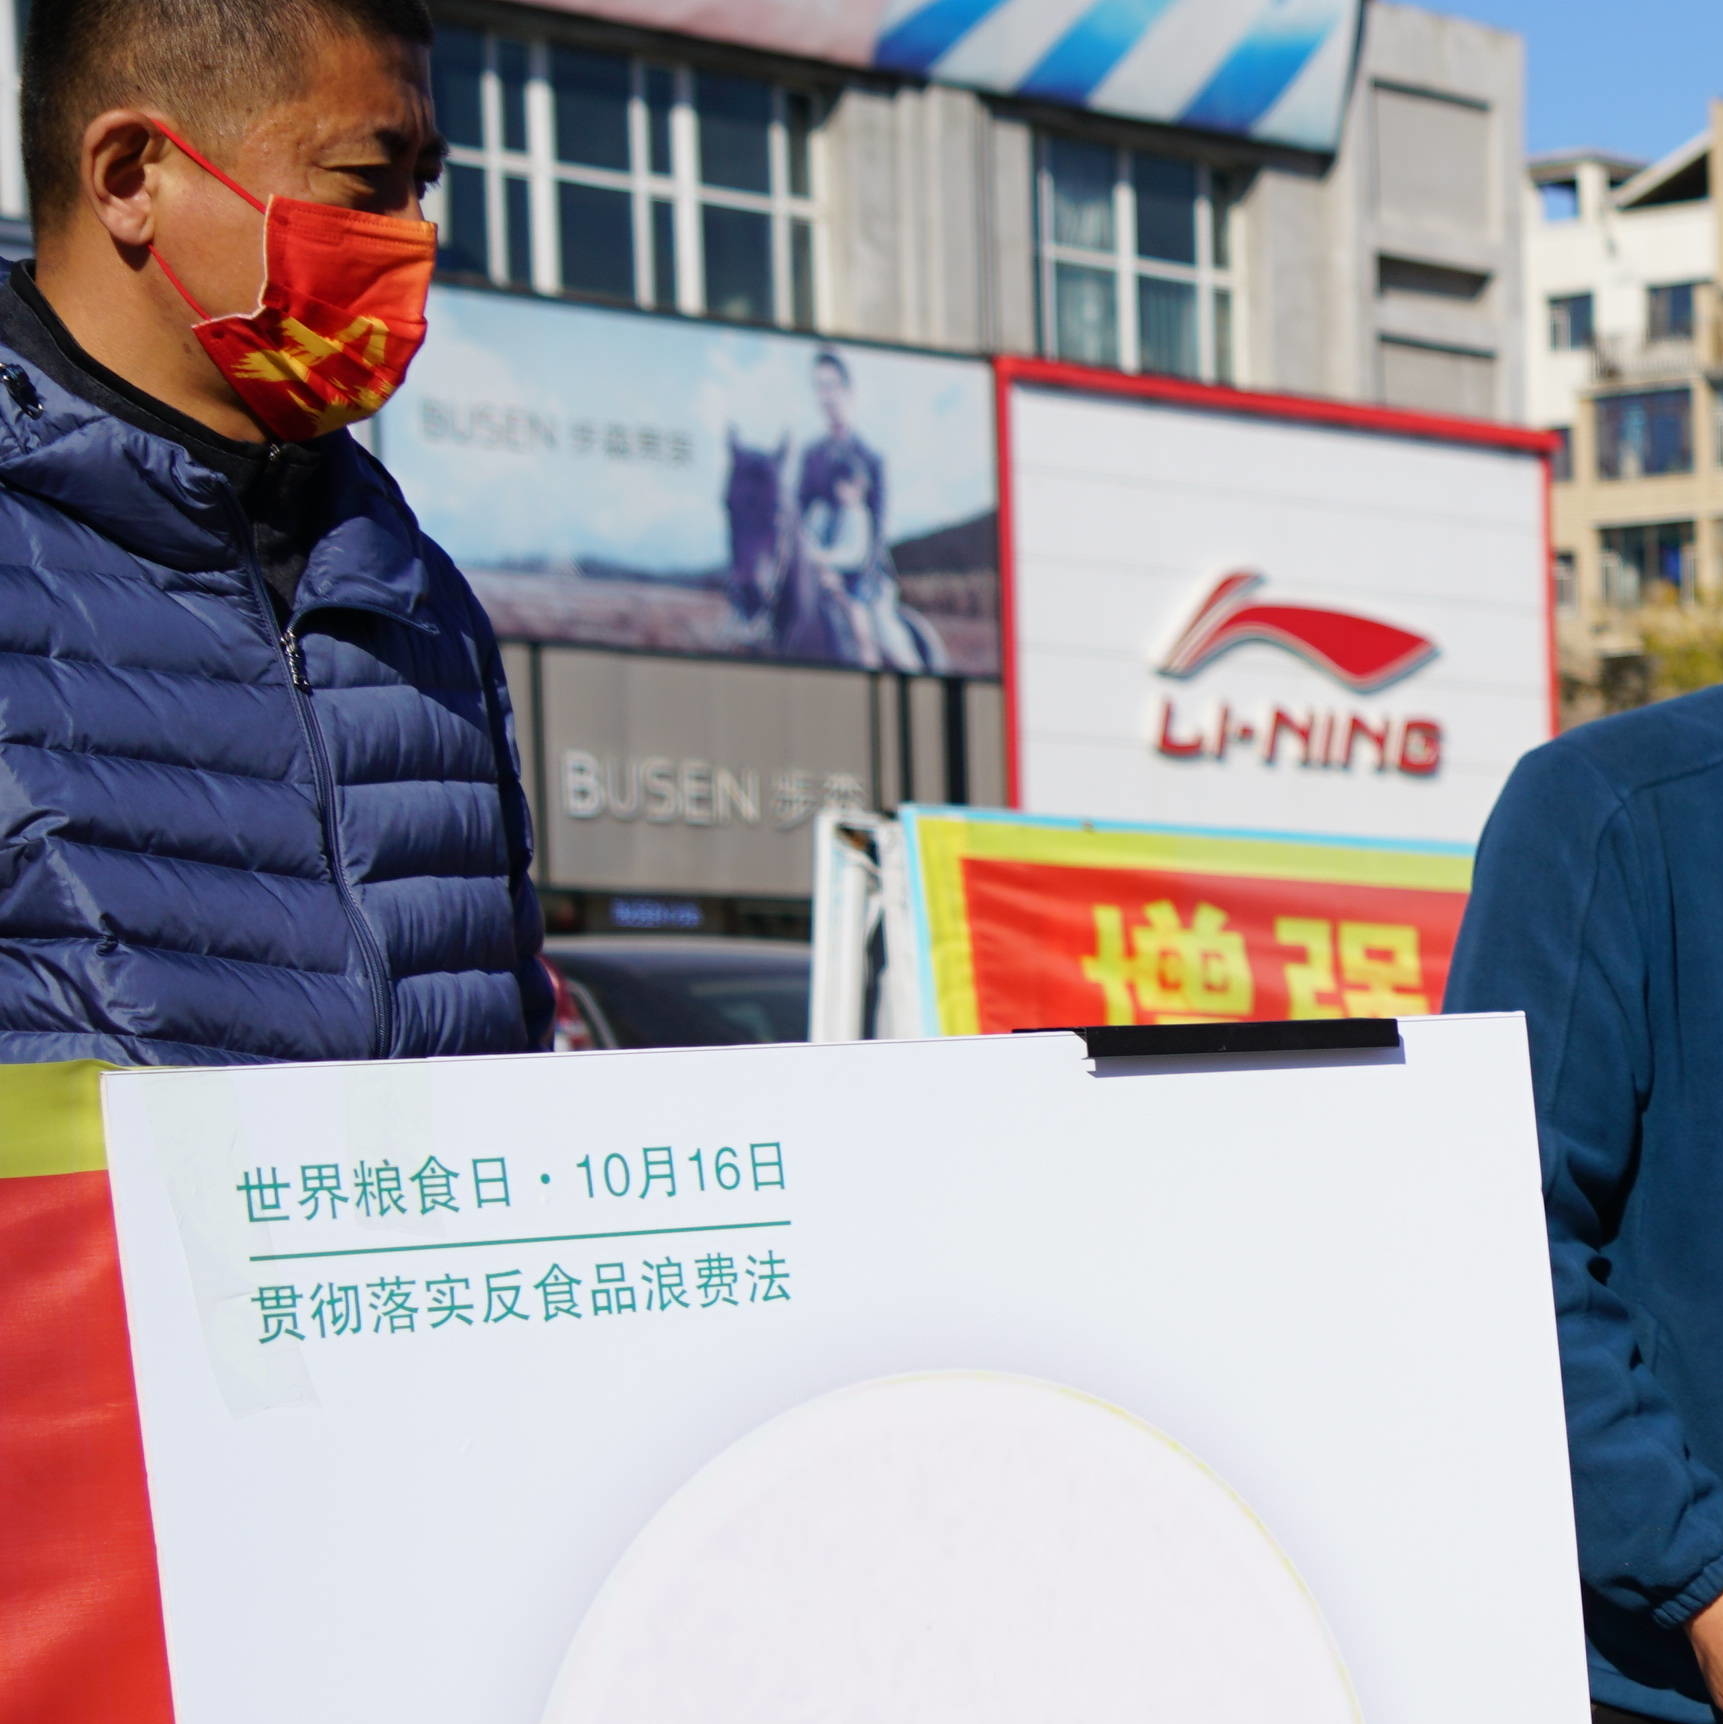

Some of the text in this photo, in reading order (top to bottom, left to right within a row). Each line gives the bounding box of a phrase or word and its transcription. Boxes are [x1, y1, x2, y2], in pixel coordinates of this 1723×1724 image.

[560, 748, 762, 828] BUSEN
[250, 1250, 793, 1345] 贯彻落实反食品浪费法
